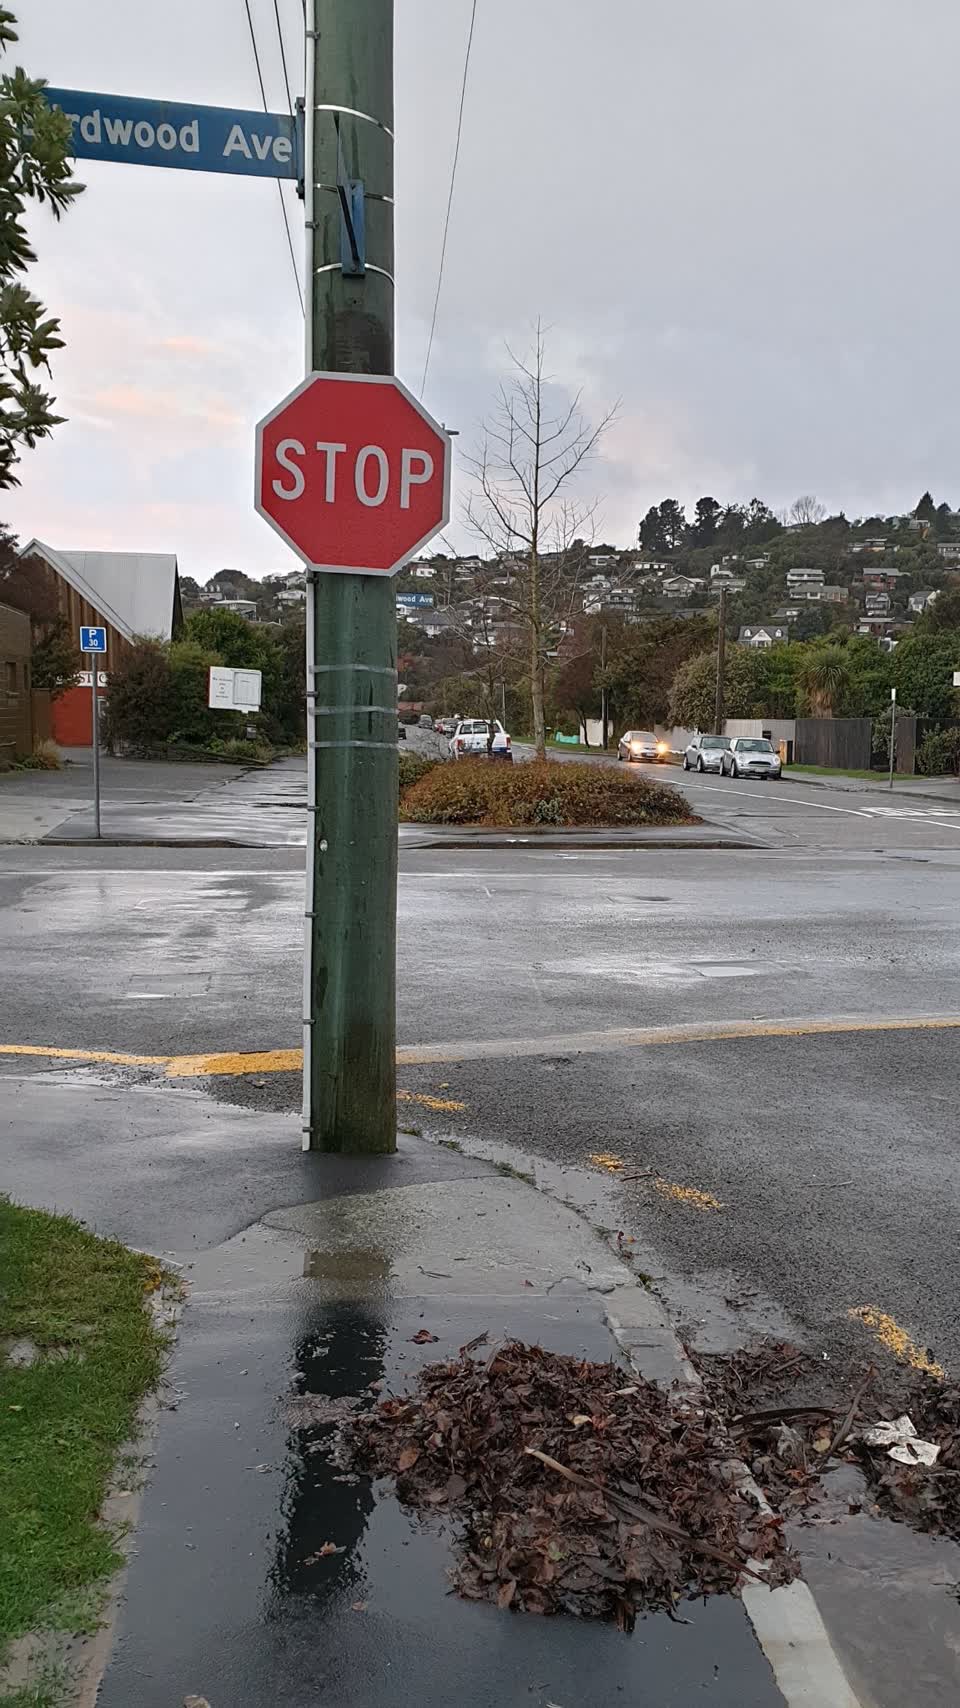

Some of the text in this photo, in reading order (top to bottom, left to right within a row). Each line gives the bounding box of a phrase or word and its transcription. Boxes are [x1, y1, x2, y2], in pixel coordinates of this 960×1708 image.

[23, 104, 293, 163] rdwood Ave
[272, 438, 434, 509] STOP
[88, 639, 99, 647] 30
[89, 629, 97, 639] P
